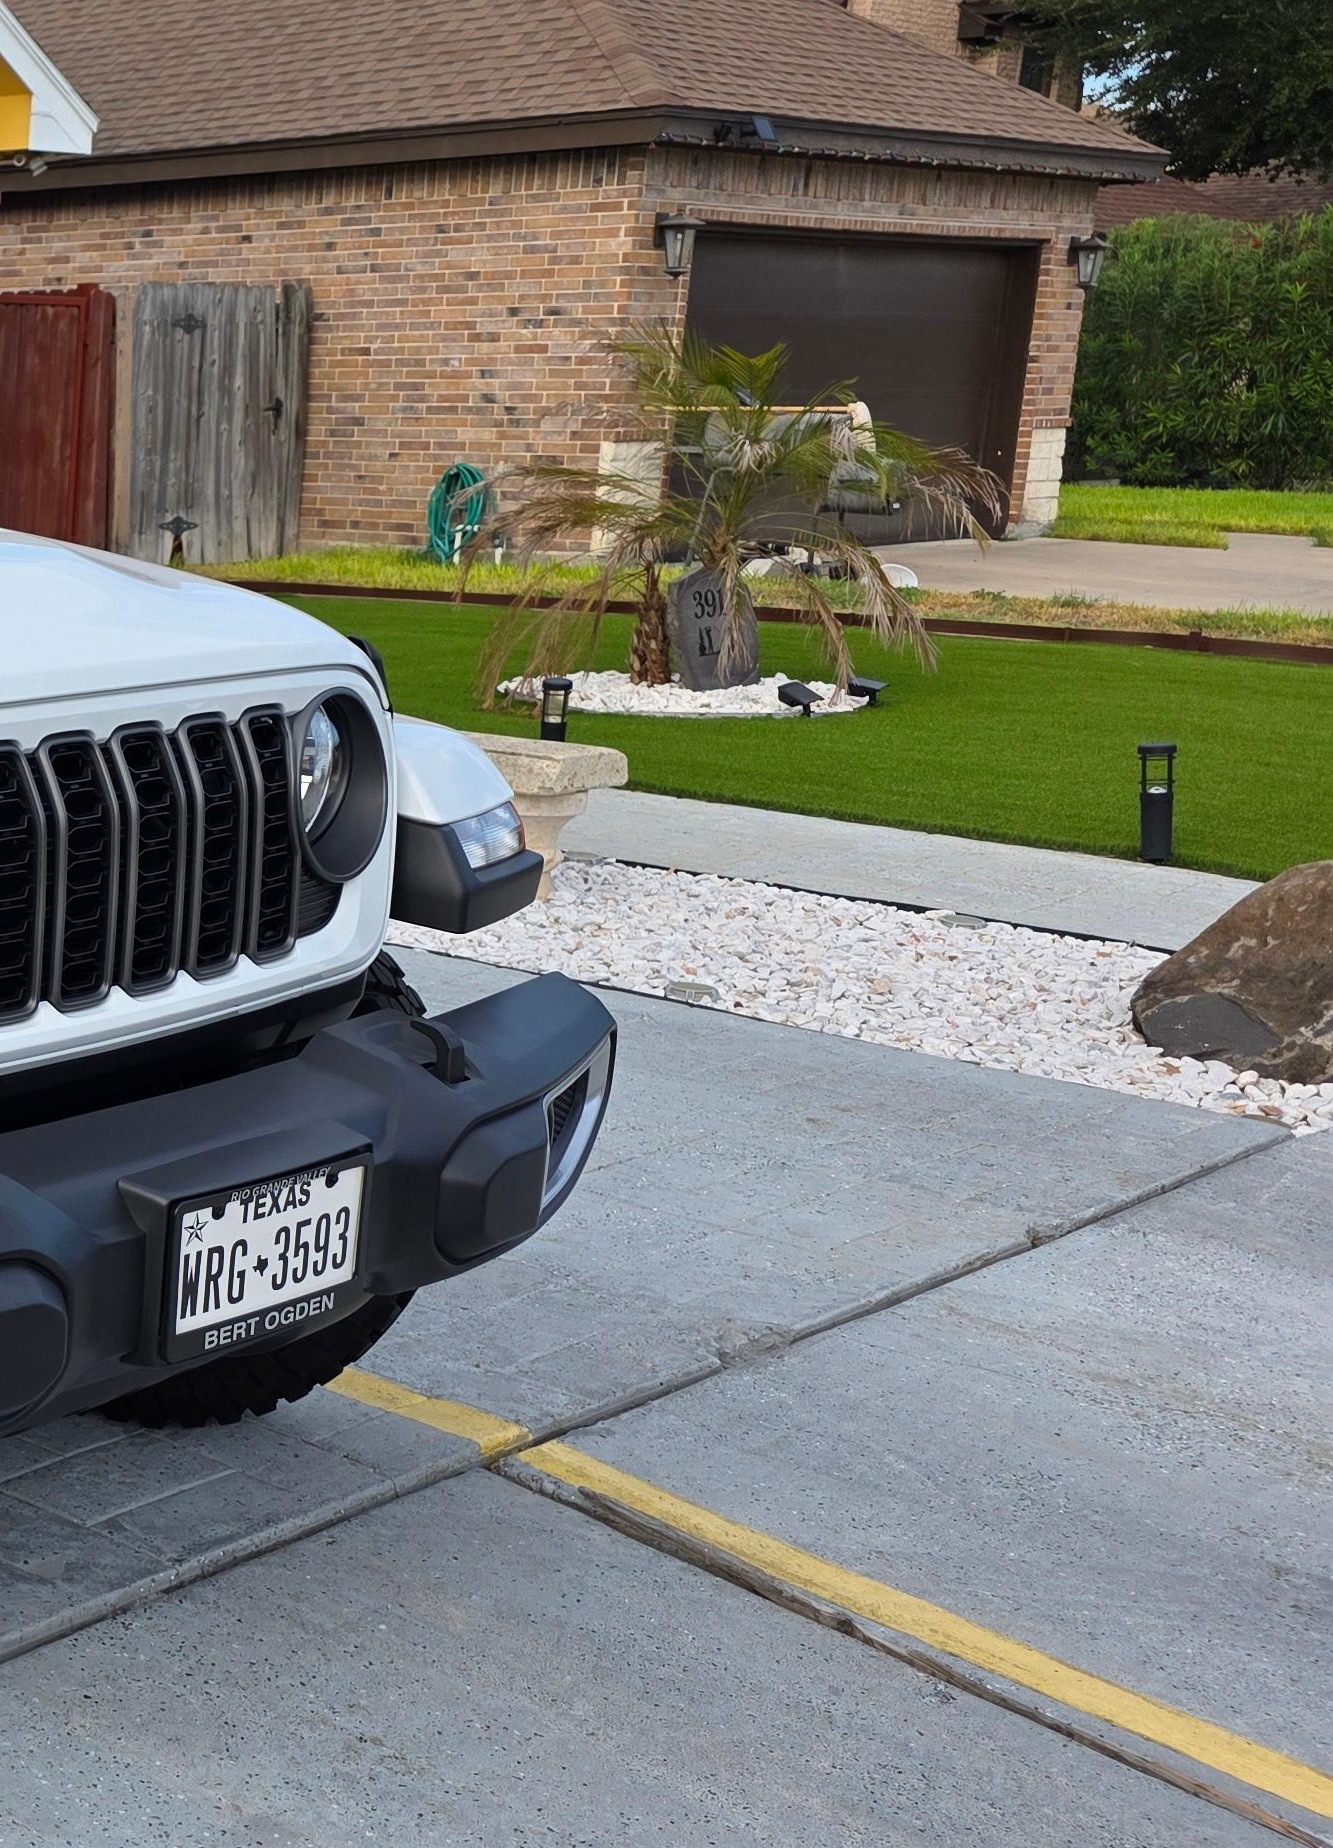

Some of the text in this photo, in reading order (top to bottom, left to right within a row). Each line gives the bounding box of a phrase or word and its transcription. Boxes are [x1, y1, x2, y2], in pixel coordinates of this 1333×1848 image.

[231, 1166, 331, 1202] RIO GRANDE VALLEY
[240, 1181, 312, 1224] TEXAS
[179, 1206, 351, 1320] WRG 3593
[205, 1292, 335, 1350] BERT OGDEN
